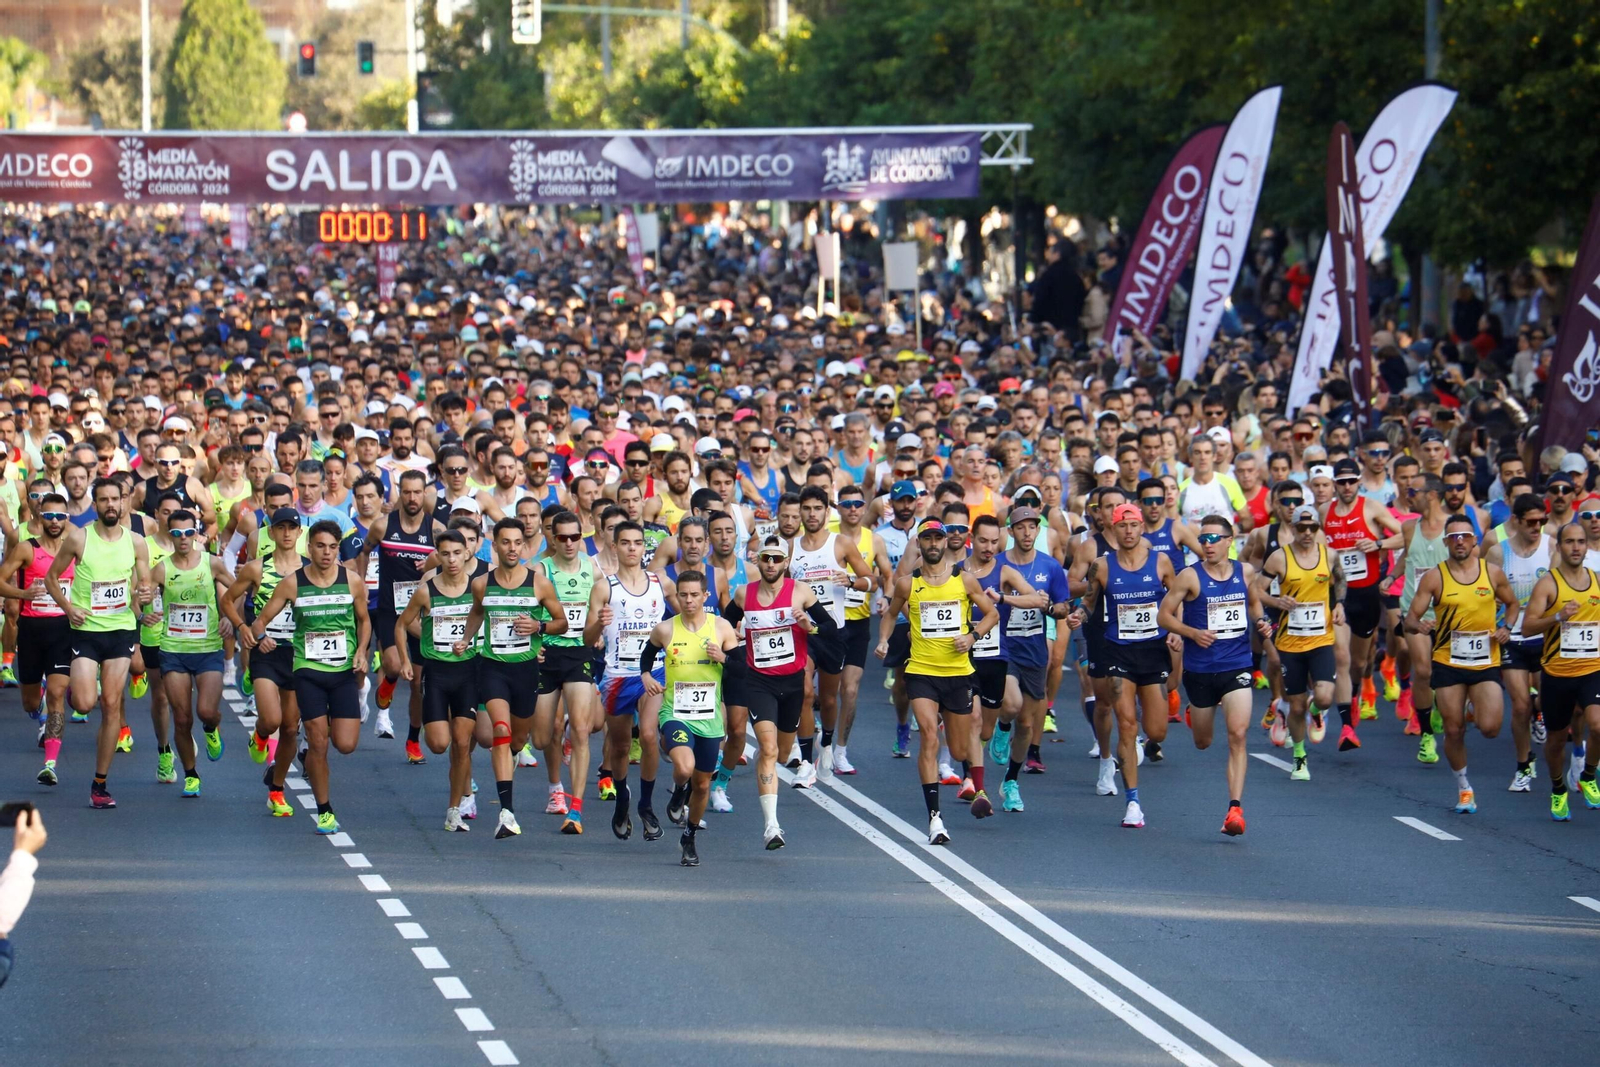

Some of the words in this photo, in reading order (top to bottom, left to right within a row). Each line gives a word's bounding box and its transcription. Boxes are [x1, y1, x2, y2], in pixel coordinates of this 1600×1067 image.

[147, 149, 198, 164] MEDIA
[537, 150, 587, 166] MEDIA
[869, 145, 971, 165] AYUNTAMIENTO
[117, 159, 147, 181] 38
[147, 160, 230, 181] MARATÓN
[265, 149, 457, 192] SALIDA
[508, 161, 537, 184] 38
[537, 161, 618, 182] MARATÓN
[687, 154, 794, 179] IMDECO
[869, 165, 888, 184] DE
[147, 181, 198, 196] CÓRDOBA
[202, 182, 230, 196] 2024
[537, 182, 586, 197] CÓRDOBA
[589, 183, 617, 197] 2024
[319, 211, 427, 243] 00:00:11
[1119, 164, 1203, 326] IMDECO
[1343, 554, 1358, 566] 55
[104, 586, 125, 599] 403
[1112, 590, 1156, 600] TROTASIERRA
[180, 612, 203, 623] 173
[568, 609, 582, 621] 57
[936, 608, 953, 621] 62
[1022, 609, 1036, 621] 32
[1135, 611, 1151, 623] 28
[1225, 609, 1240, 622] 26
[1304, 609, 1318, 621] 17
[450, 624, 466, 636] 23
[1578, 629, 1593, 642] 15
[323, 639, 338, 651] 21
[769, 636, 785, 649] 64
[1468, 639, 1483, 651] 16
[692, 690, 707, 703] 37
